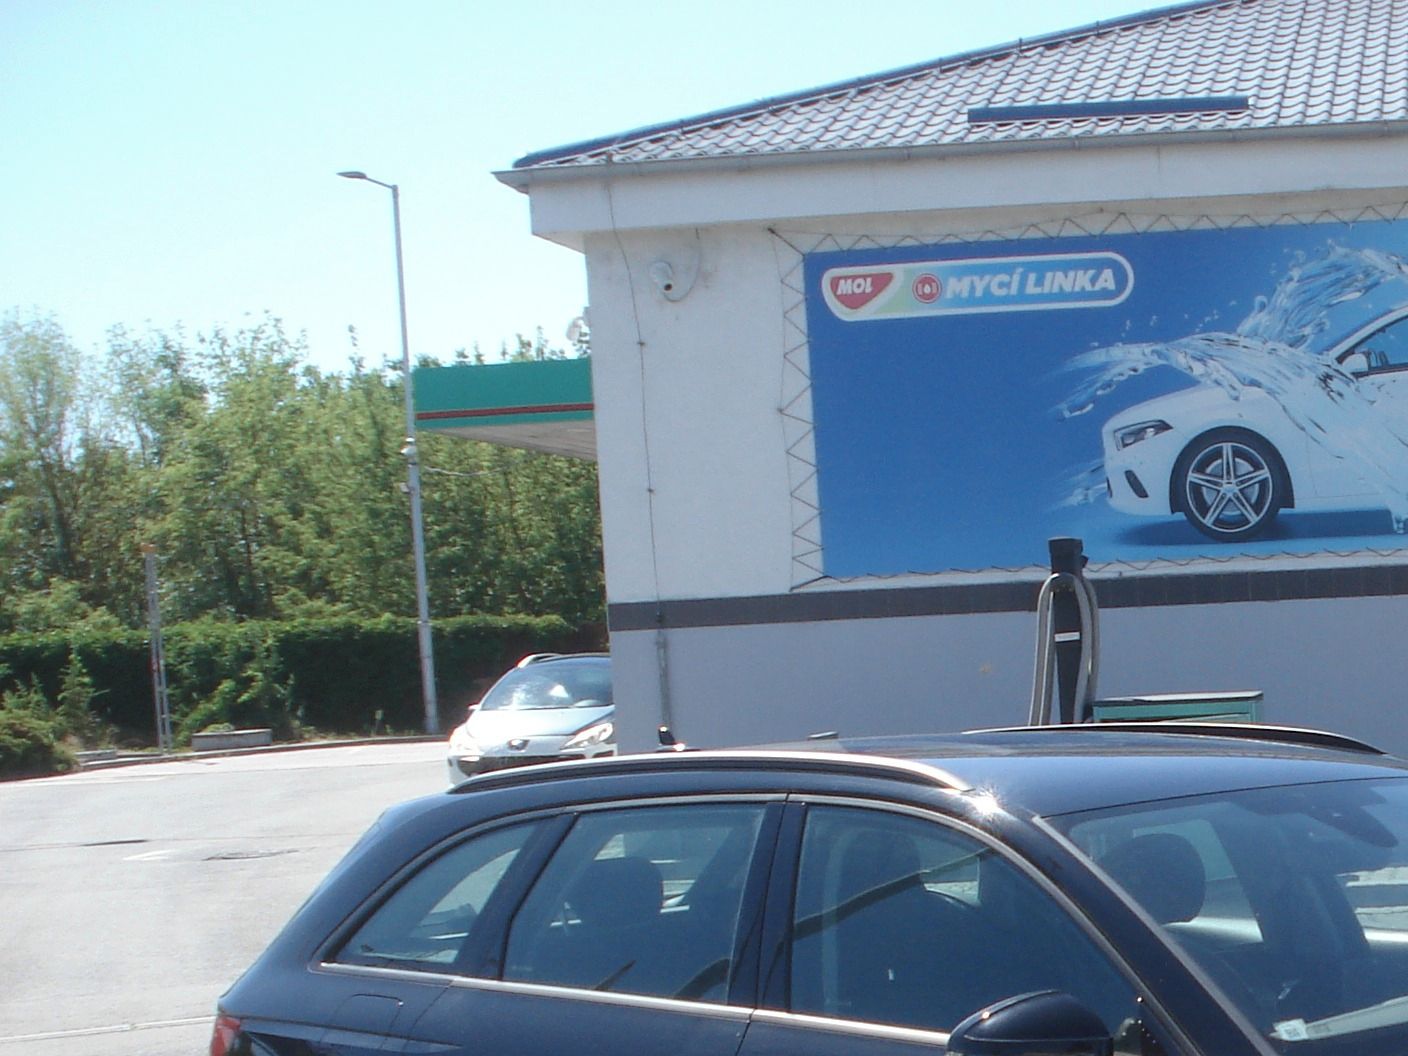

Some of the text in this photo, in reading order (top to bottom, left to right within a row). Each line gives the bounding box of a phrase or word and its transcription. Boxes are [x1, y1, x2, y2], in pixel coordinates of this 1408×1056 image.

[836, 278, 874, 295] MOL
[946, 267, 1116, 298] MYCÍ LINKA
